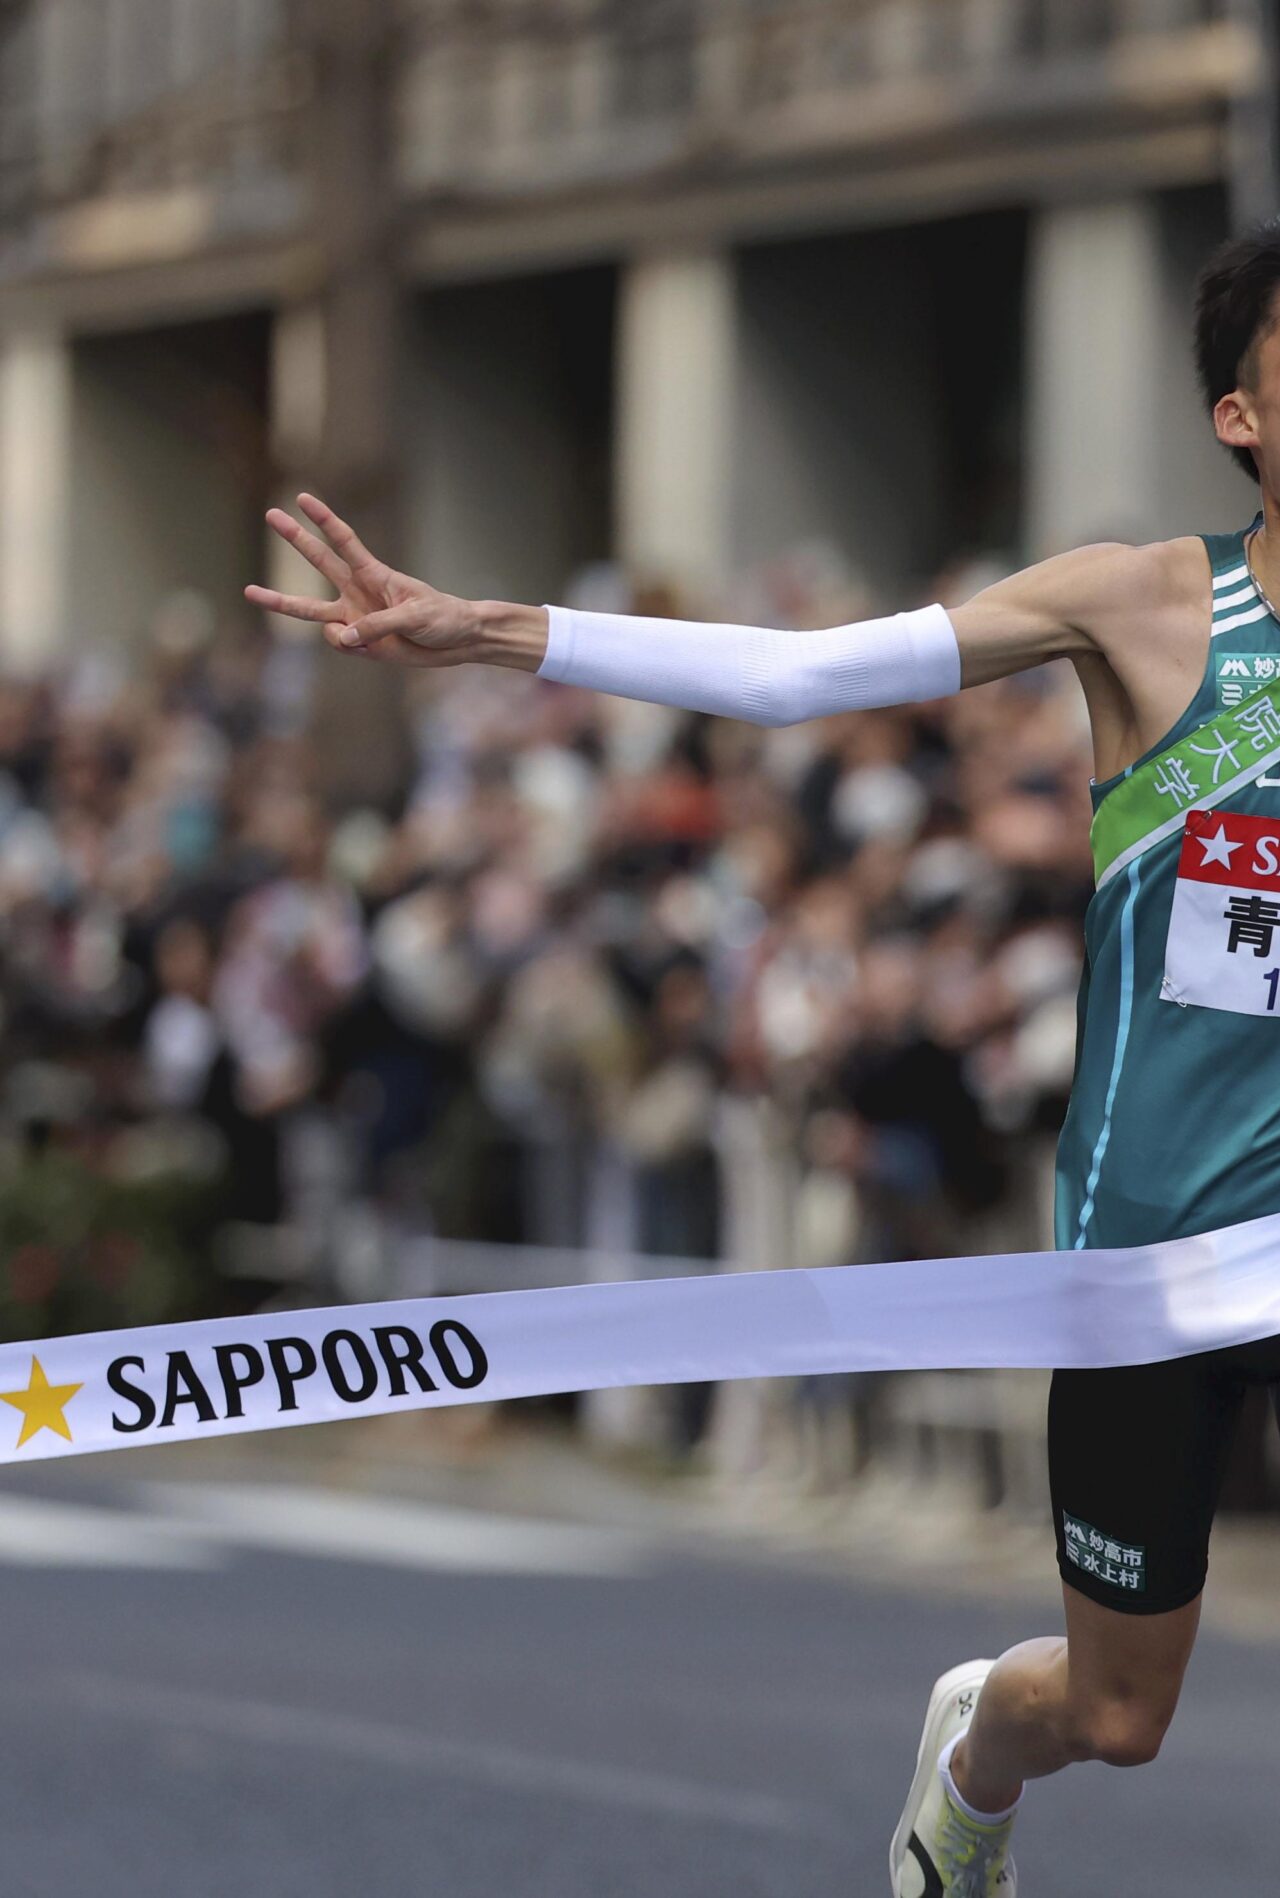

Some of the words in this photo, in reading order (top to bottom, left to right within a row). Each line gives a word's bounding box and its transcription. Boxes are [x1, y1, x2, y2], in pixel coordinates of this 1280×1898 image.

[106, 1319, 489, 1433] SAPPORO
[1088, 1529, 1143, 1567] 妙高市
[1083, 1553, 1140, 1589] 水上村
